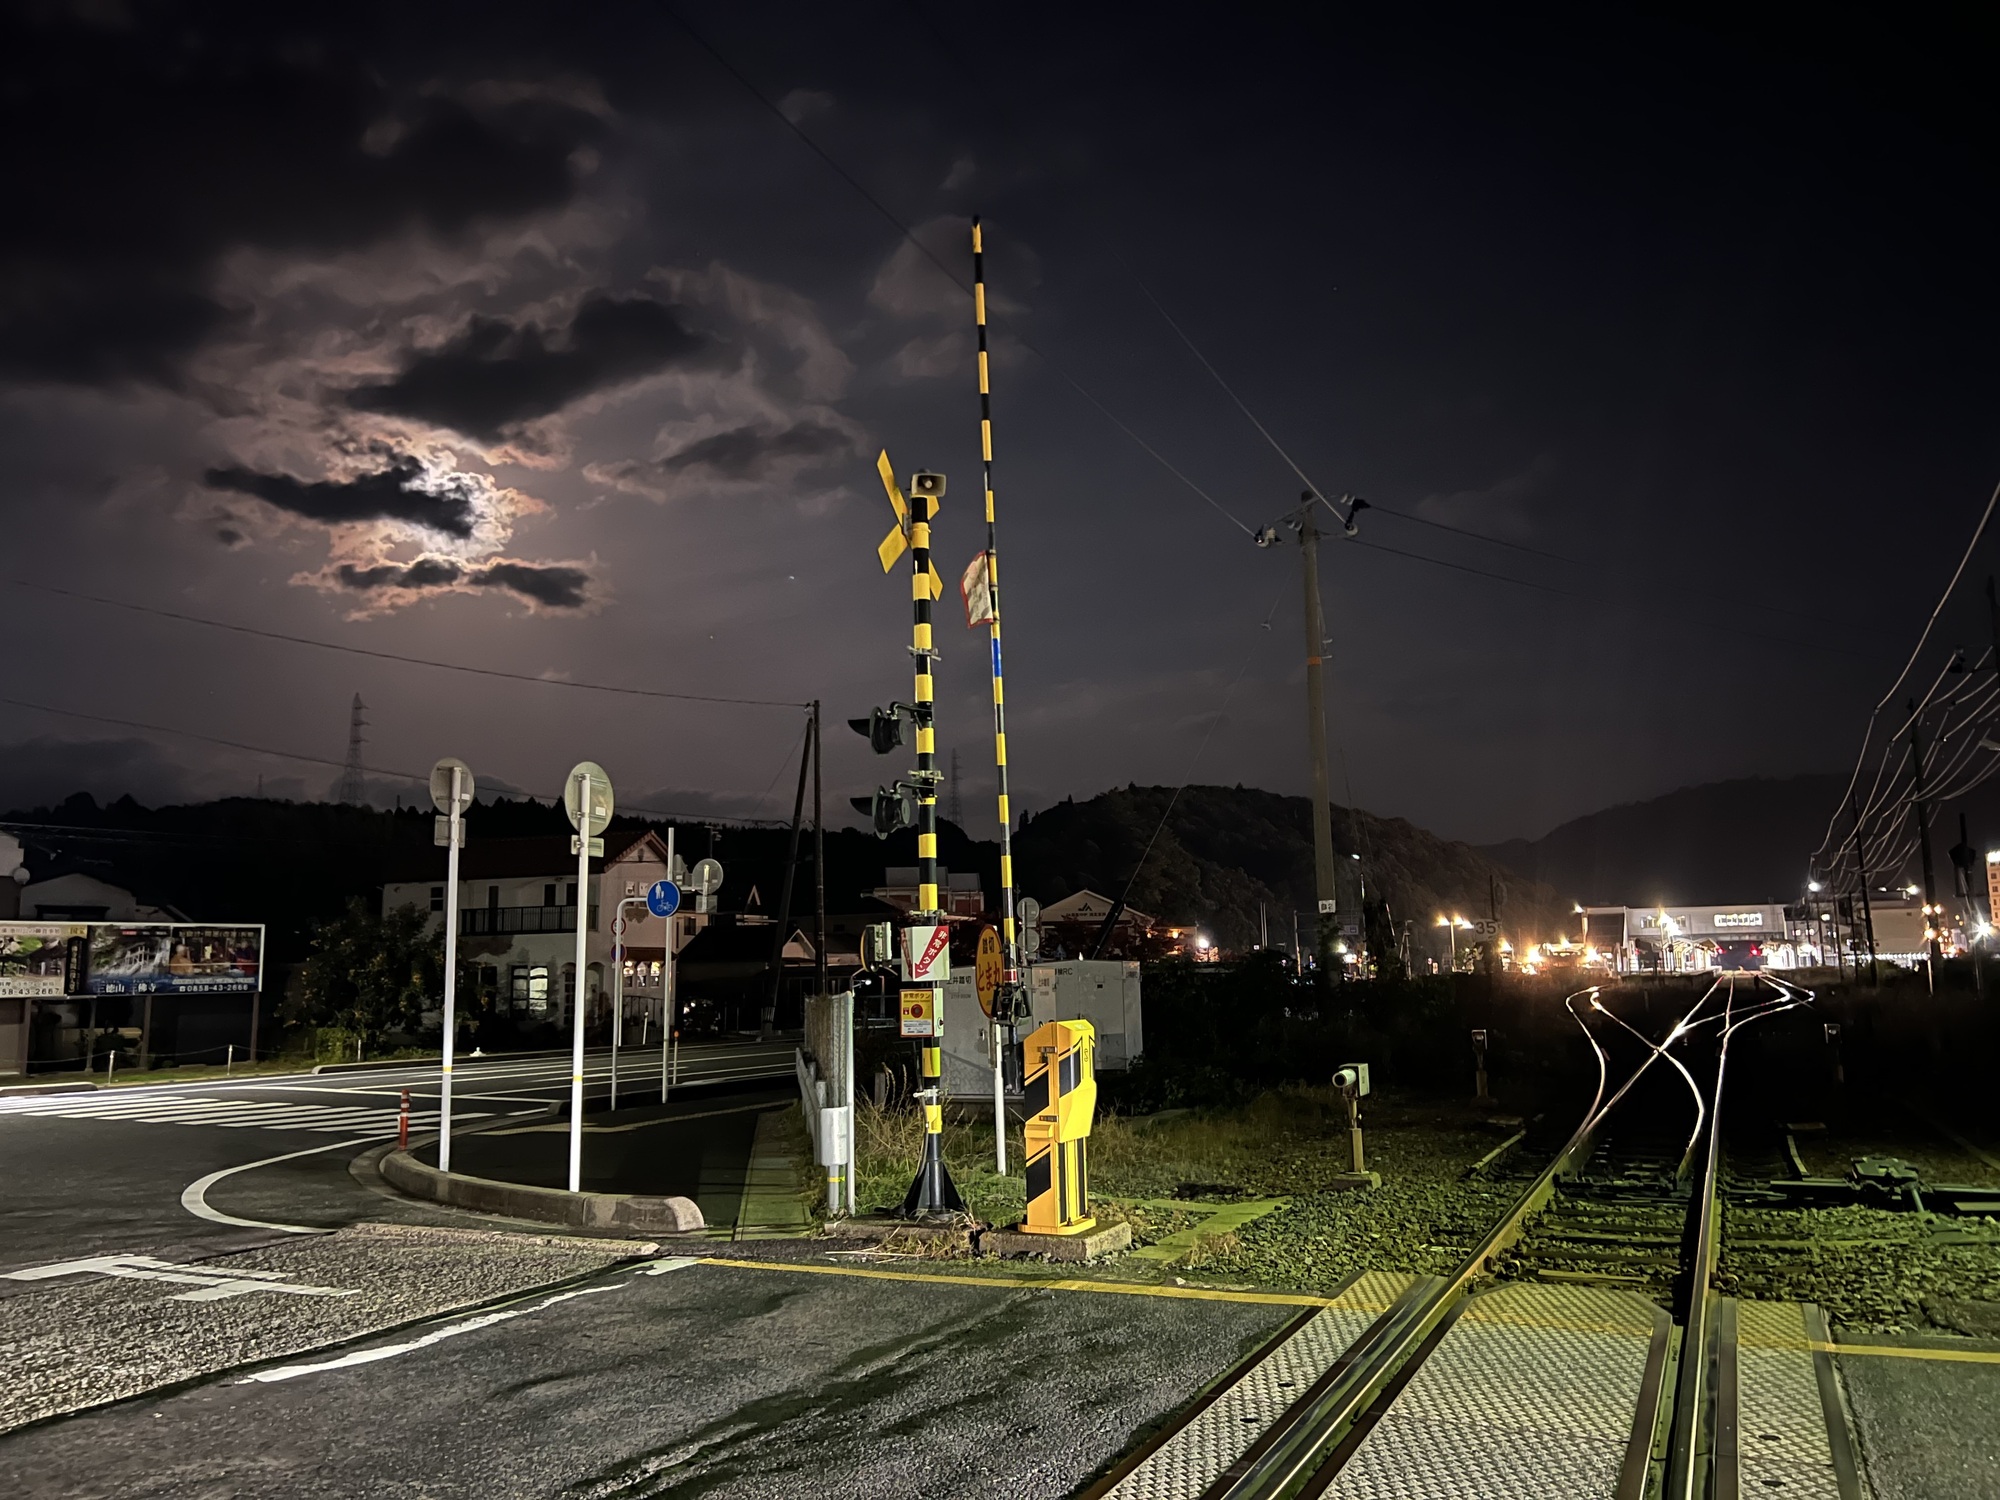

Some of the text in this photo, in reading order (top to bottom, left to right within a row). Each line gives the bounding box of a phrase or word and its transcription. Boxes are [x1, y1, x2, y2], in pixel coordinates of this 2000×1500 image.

[1475, 921, 1496, 935] 35
[917, 930, 948, 973] 非常ボタン
[982, 936, 995, 955] 踏切
[978, 961, 1001, 992] とまれ
